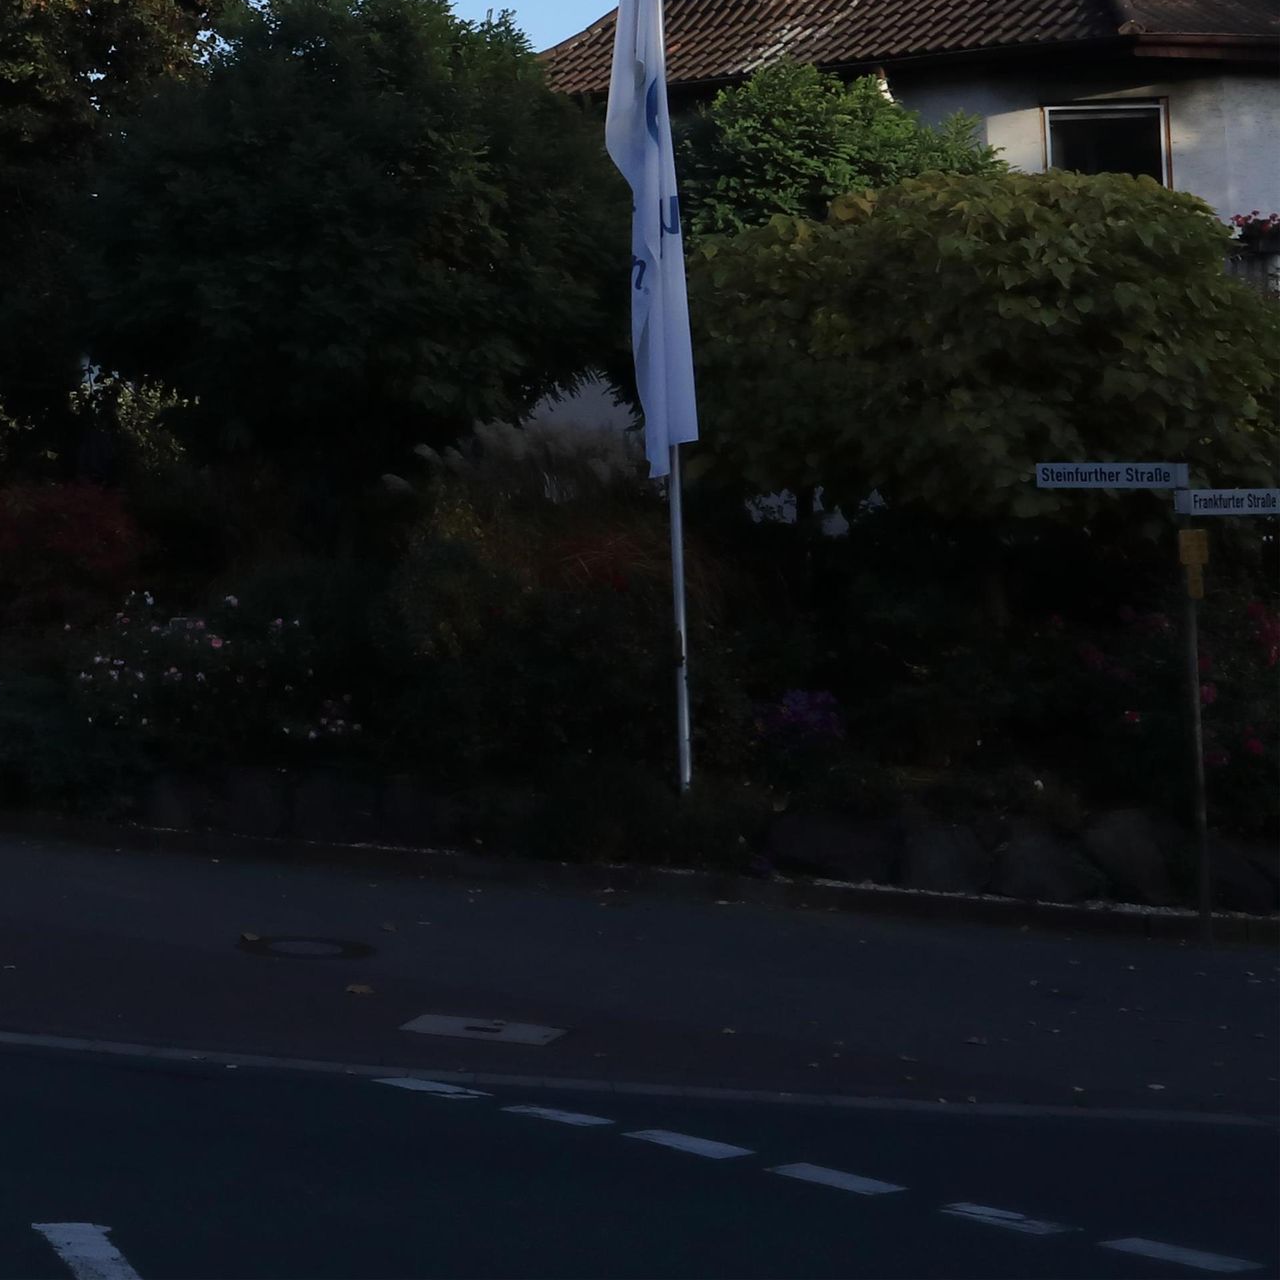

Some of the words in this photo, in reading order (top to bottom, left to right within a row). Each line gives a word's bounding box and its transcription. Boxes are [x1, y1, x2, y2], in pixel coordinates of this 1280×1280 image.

[1041, 467, 1120, 482] Steinfurther
[1125, 467, 1171, 482] Straße
[1193, 494, 1244, 509] Frankfurter
[1247, 493, 1277, 508] Straße
